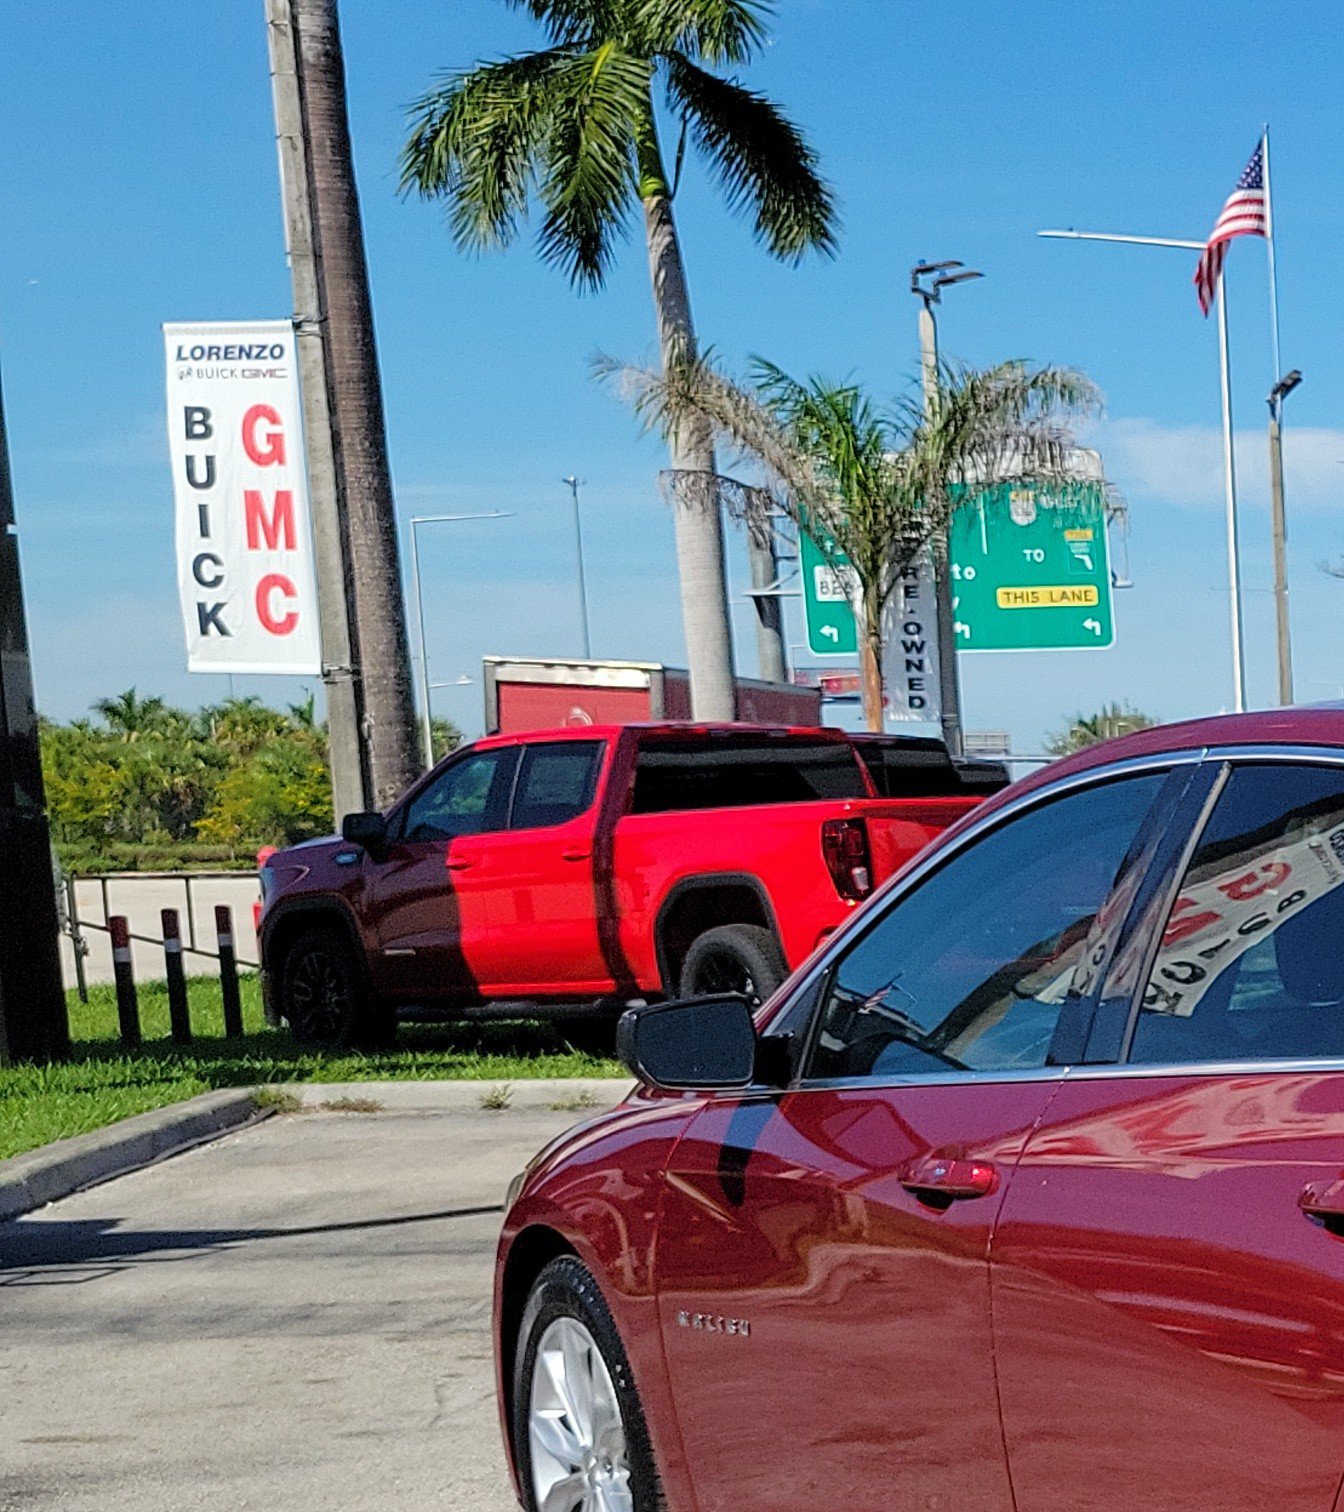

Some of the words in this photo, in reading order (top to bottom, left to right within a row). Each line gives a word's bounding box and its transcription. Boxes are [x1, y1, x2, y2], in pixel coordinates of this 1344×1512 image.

[176, 343, 286, 362] LORENZO
[196, 368, 239, 379] BUICK
[183, 405, 234, 637] BUICK
[241, 403, 300, 637] GMC
[1023, 549, 1046, 563] TO
[1003, 591, 1041, 604] THIS
[1049, 589, 1094, 604] LANE
